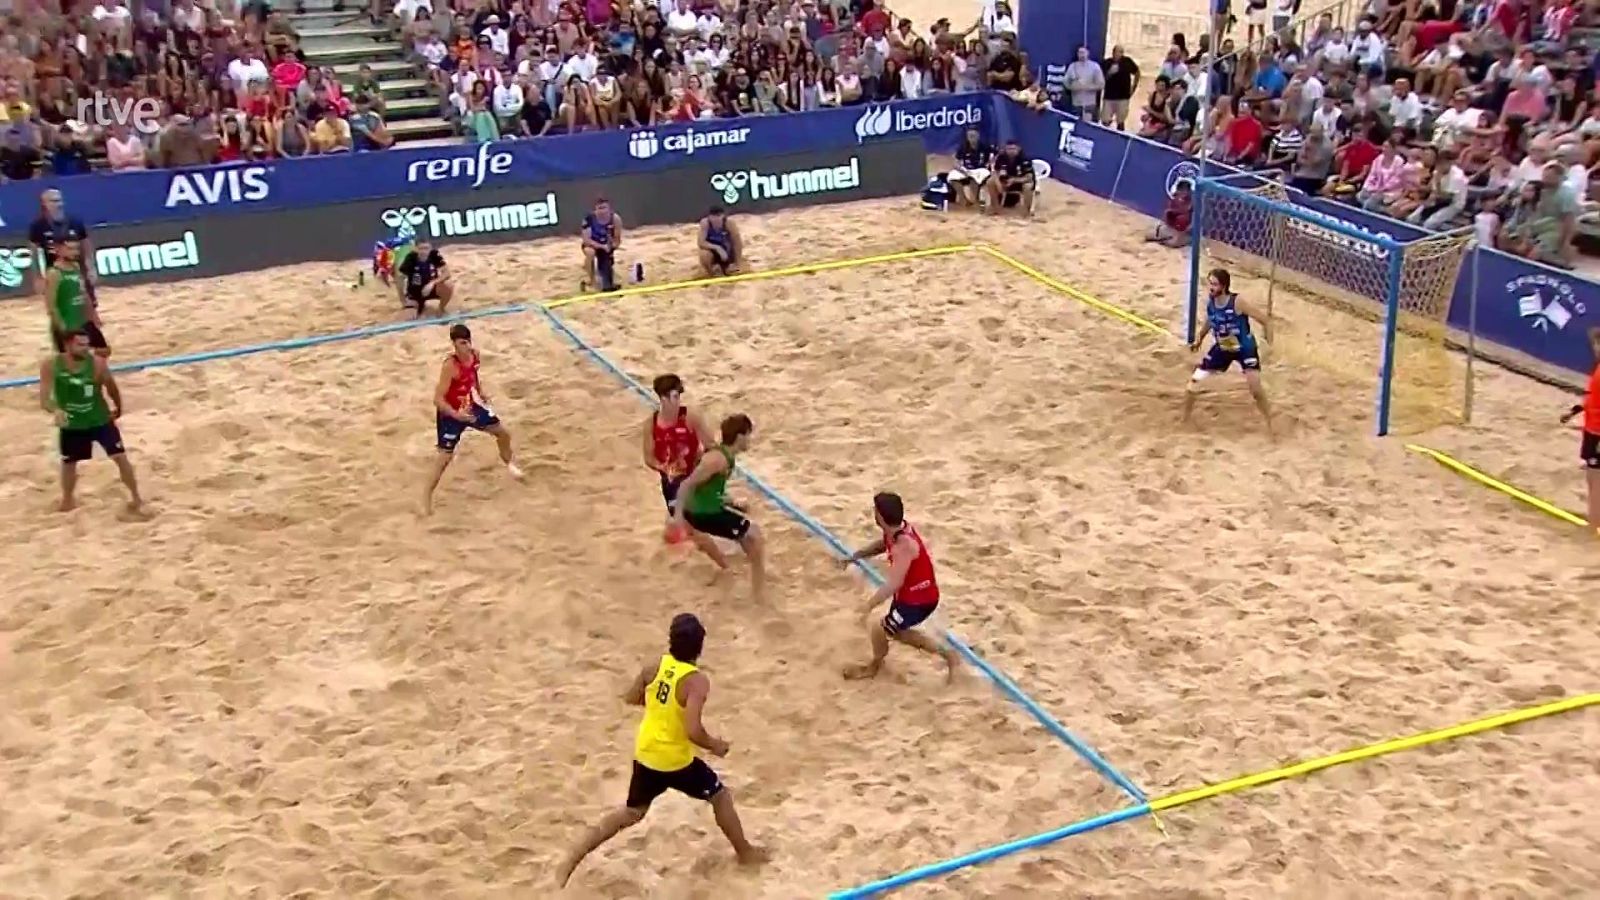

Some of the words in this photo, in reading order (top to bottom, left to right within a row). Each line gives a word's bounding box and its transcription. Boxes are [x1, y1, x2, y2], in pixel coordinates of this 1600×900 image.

[895, 104, 982, 132] Iberdrola
[663, 127, 751, 155] cajamar
[408, 140, 513, 188] renfe
[749, 157, 860, 201] hummel
[165, 167, 270, 207] AVIS
[428, 192, 559, 237] hummel
[656, 681, 670, 705] 18
